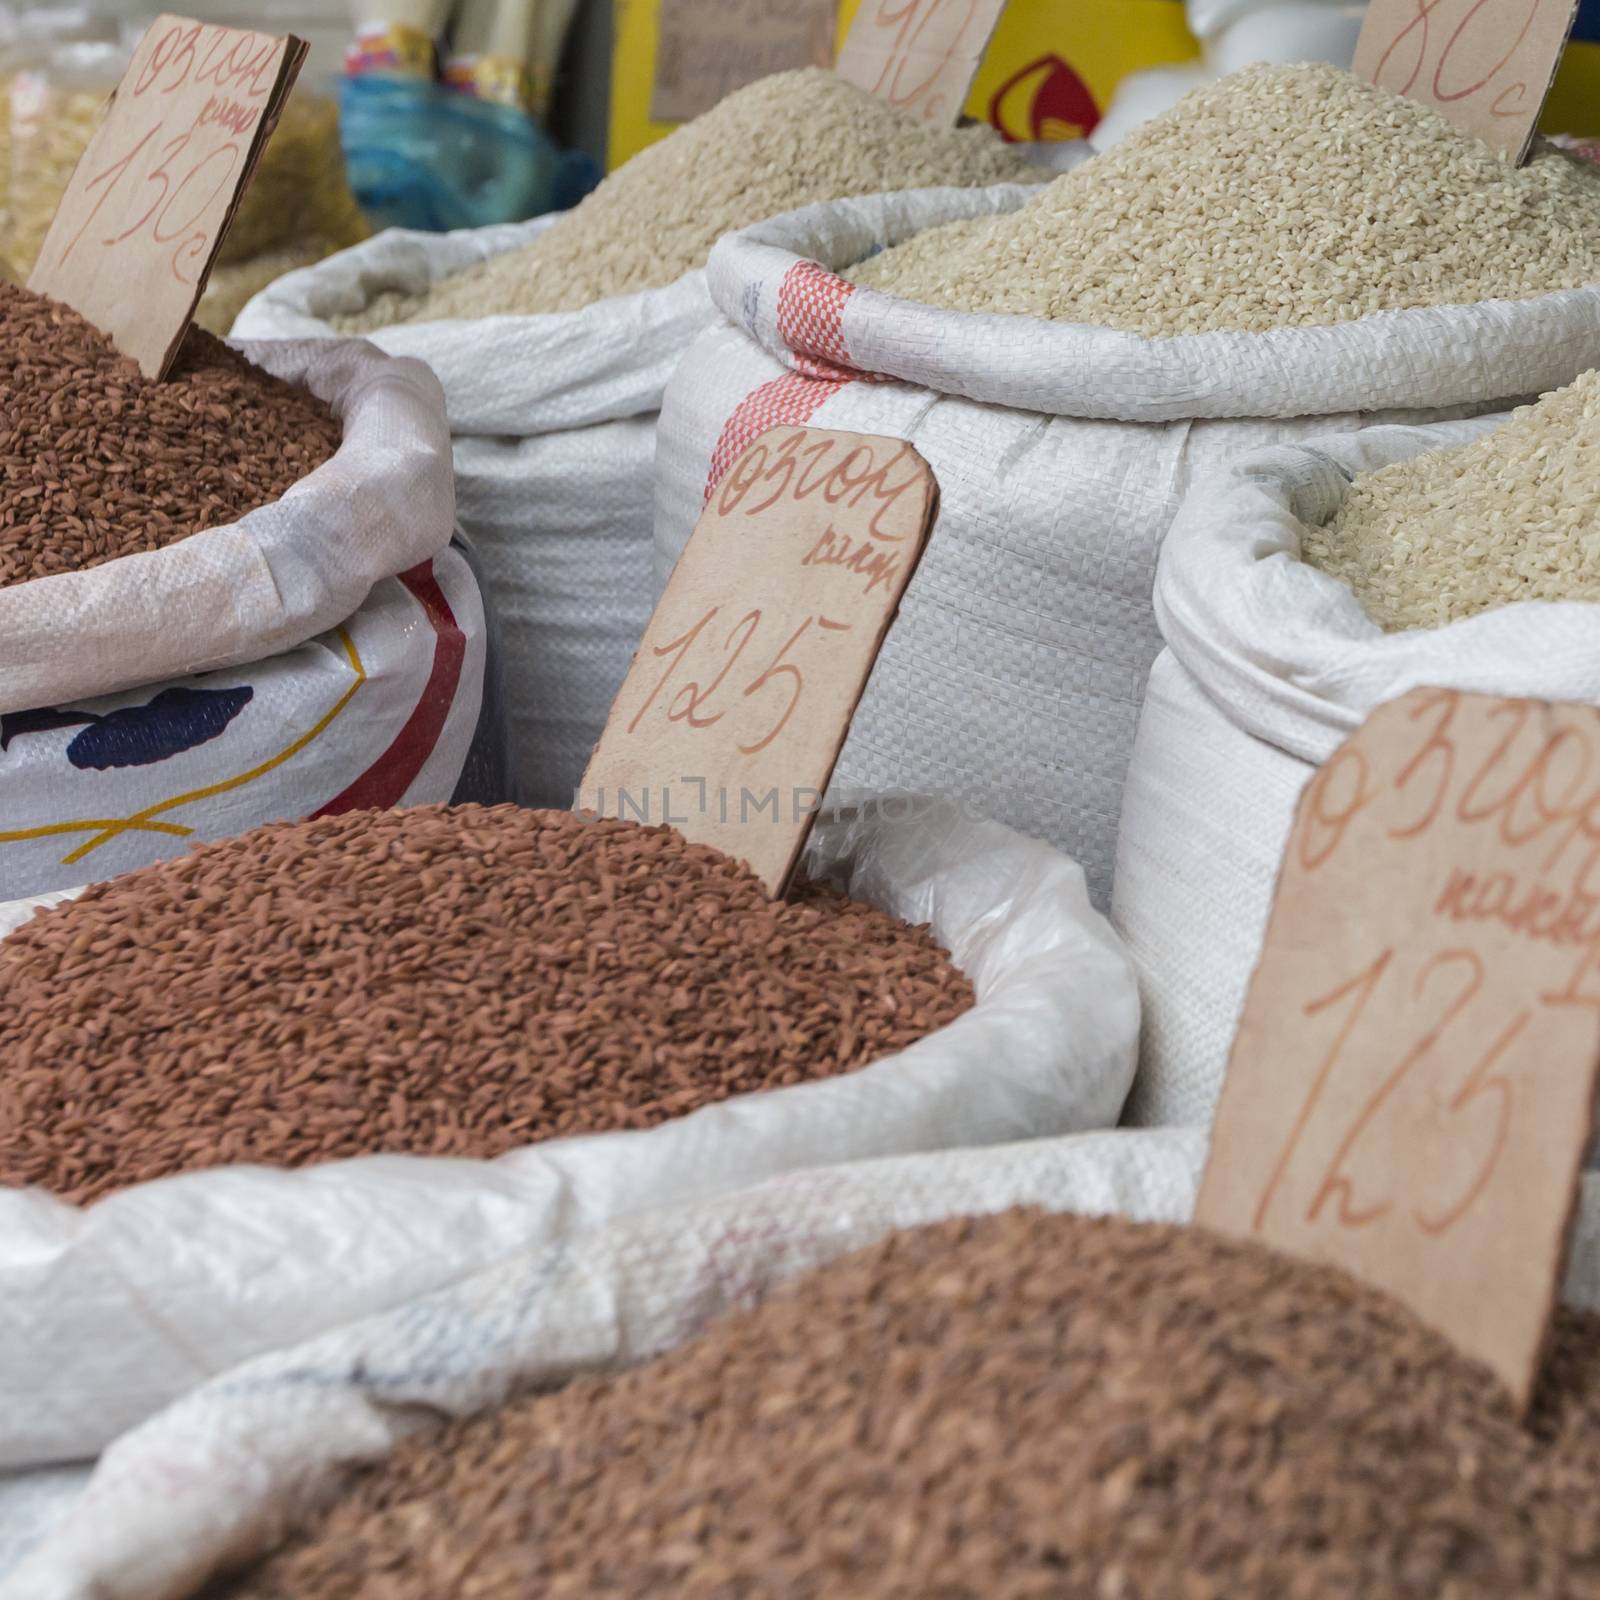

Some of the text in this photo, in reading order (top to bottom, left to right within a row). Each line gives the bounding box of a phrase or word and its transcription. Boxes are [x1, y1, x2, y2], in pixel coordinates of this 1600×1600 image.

[58, 121, 240, 269] 130
[627, 606, 853, 754] 125
[1252, 947, 1600, 1236] 125
